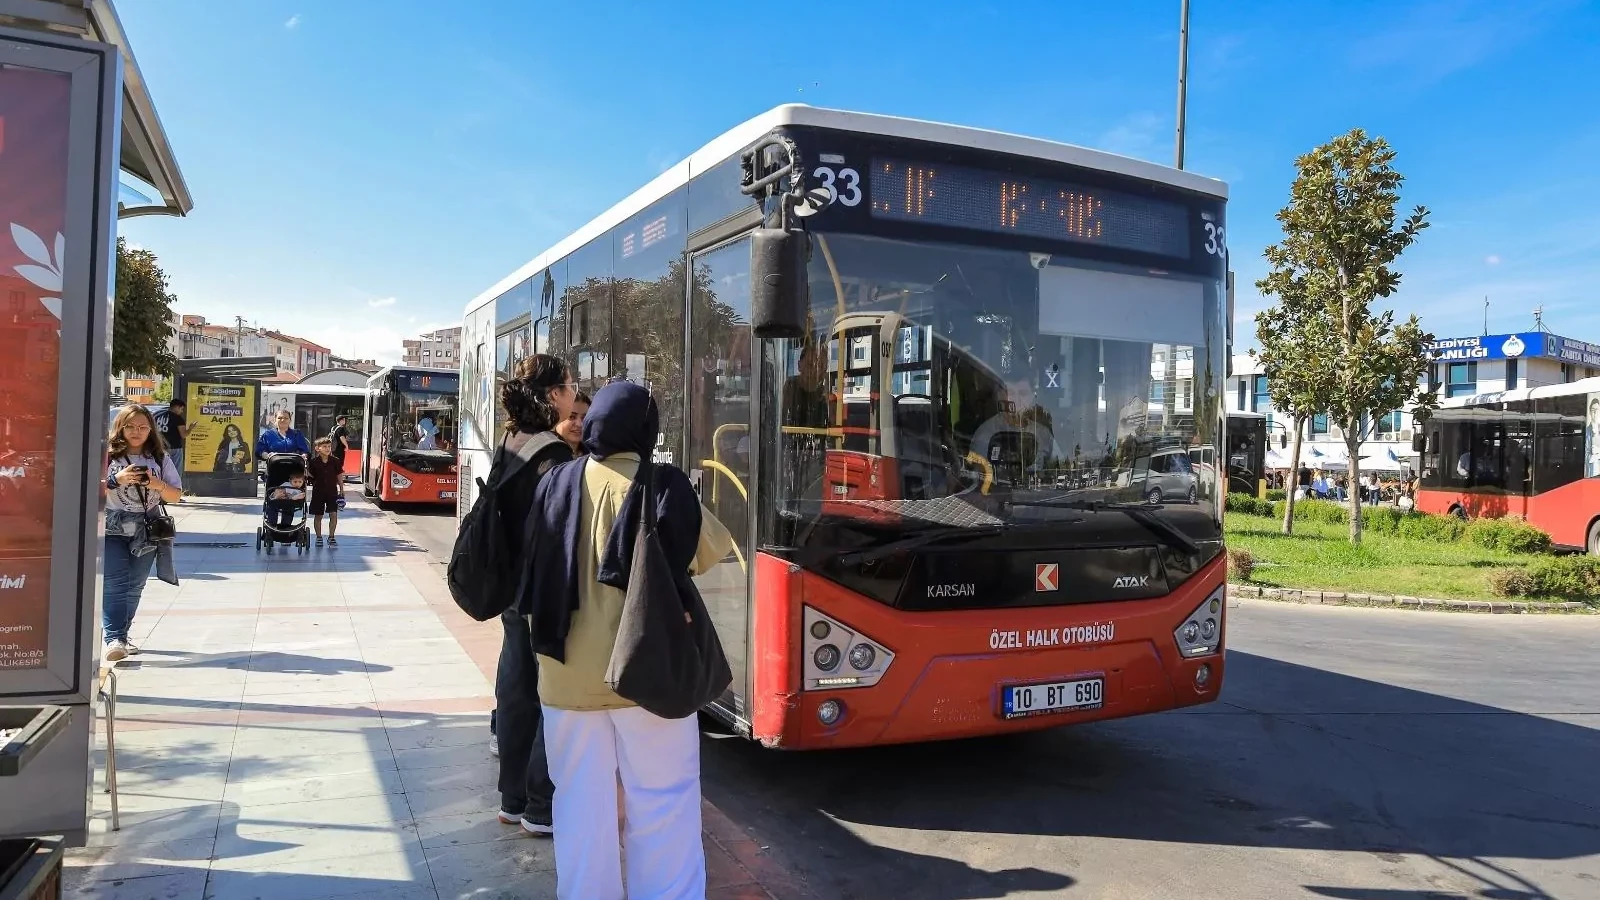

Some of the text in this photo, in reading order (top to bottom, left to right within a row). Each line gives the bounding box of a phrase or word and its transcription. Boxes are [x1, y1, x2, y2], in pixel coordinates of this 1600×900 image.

[813, 166, 862, 207] 33
[1204, 222, 1226, 259] 33
[927, 584, 975, 598] KARSAN
[1112, 575, 1149, 589] ATAK
[989, 620, 1115, 649] ÖZEL HALK OTOBÜSÜ
[1015, 681, 1101, 709] 10 BT 690
